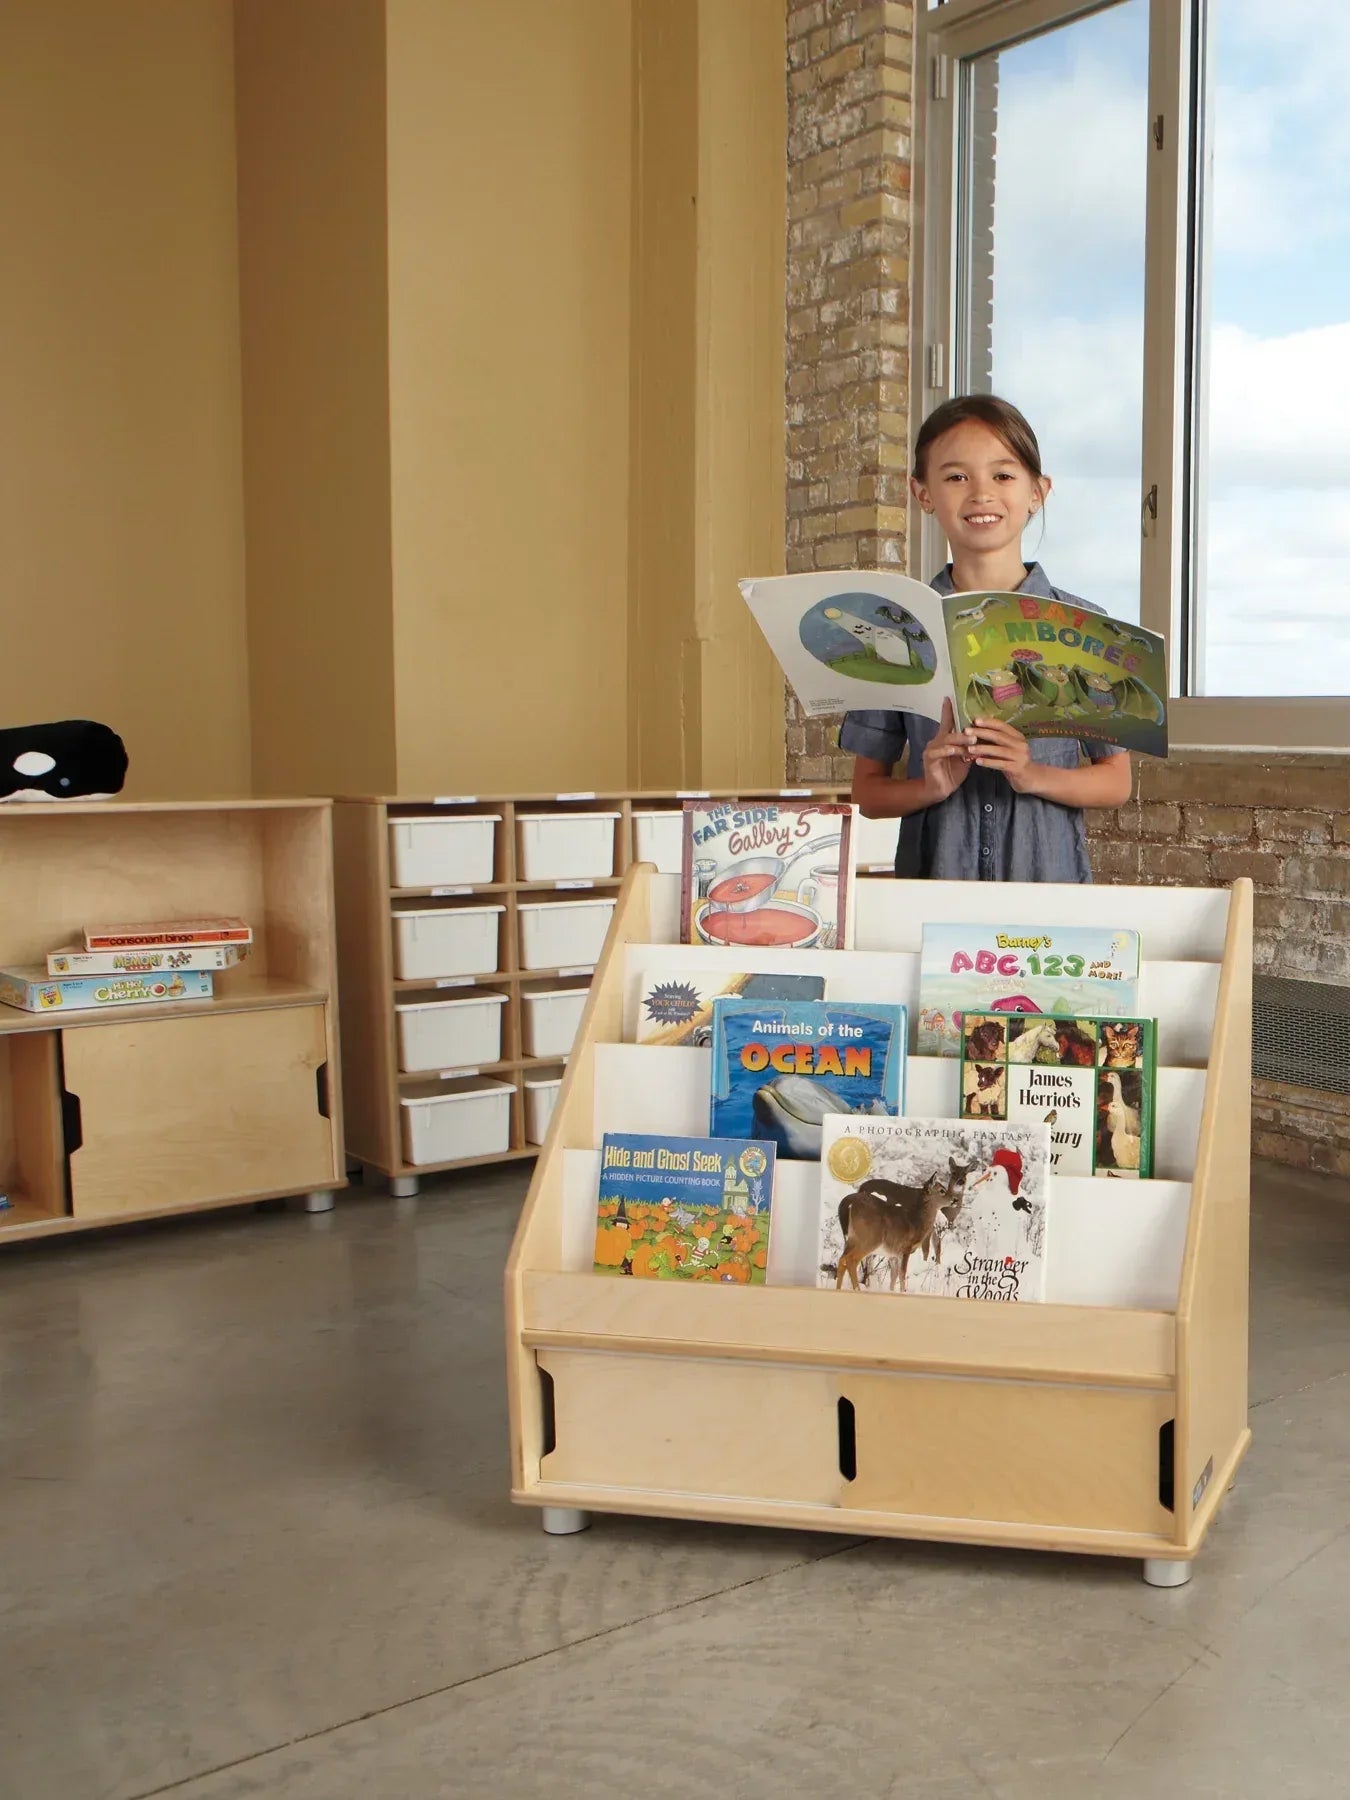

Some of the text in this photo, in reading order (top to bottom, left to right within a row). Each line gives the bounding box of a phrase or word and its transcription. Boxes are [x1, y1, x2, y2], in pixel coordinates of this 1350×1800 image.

[1018, 598, 1090, 629] BAT
[966, 621, 1142, 673] JAMBOREE
[706, 804, 733, 822] THE
[692, 807, 779, 846] FAR SIDE
[728, 807, 820, 856] Gallery 5
[109, 934, 163, 946] consonant
[165, 933, 194, 944] bingo
[996, 933, 1052, 952] Barney's
[112, 954, 163, 968] MEMORY
[1090, 961, 1112, 970] AND
[1088, 971, 1123, 981] MORE!
[752, 1020, 863, 1038] Animals of the
[740, 1042, 873, 1077] OCEAN
[1029, 1069, 1072, 1088] James
[1019, 1089, 1081, 1109] Herriot's
[844, 1126, 1032, 1142] A PHOTOGRAPHIC FANTASY
[604, 1145, 629, 1169] Hide
[633, 1148, 654, 1168] and
[657, 1149, 690, 1171] Ghost
[693, 1151, 722, 1173] Seek
[609, 1173, 634, 1182] HIDDEN
[636, 1174, 663, 1183] PICTURE
[665, 1176, 700, 1186] COUNTING
[701, 1178, 721, 1187] BOOK
[954, 1251, 1029, 1286] Stranger
[968, 1272, 997, 1286] in the
